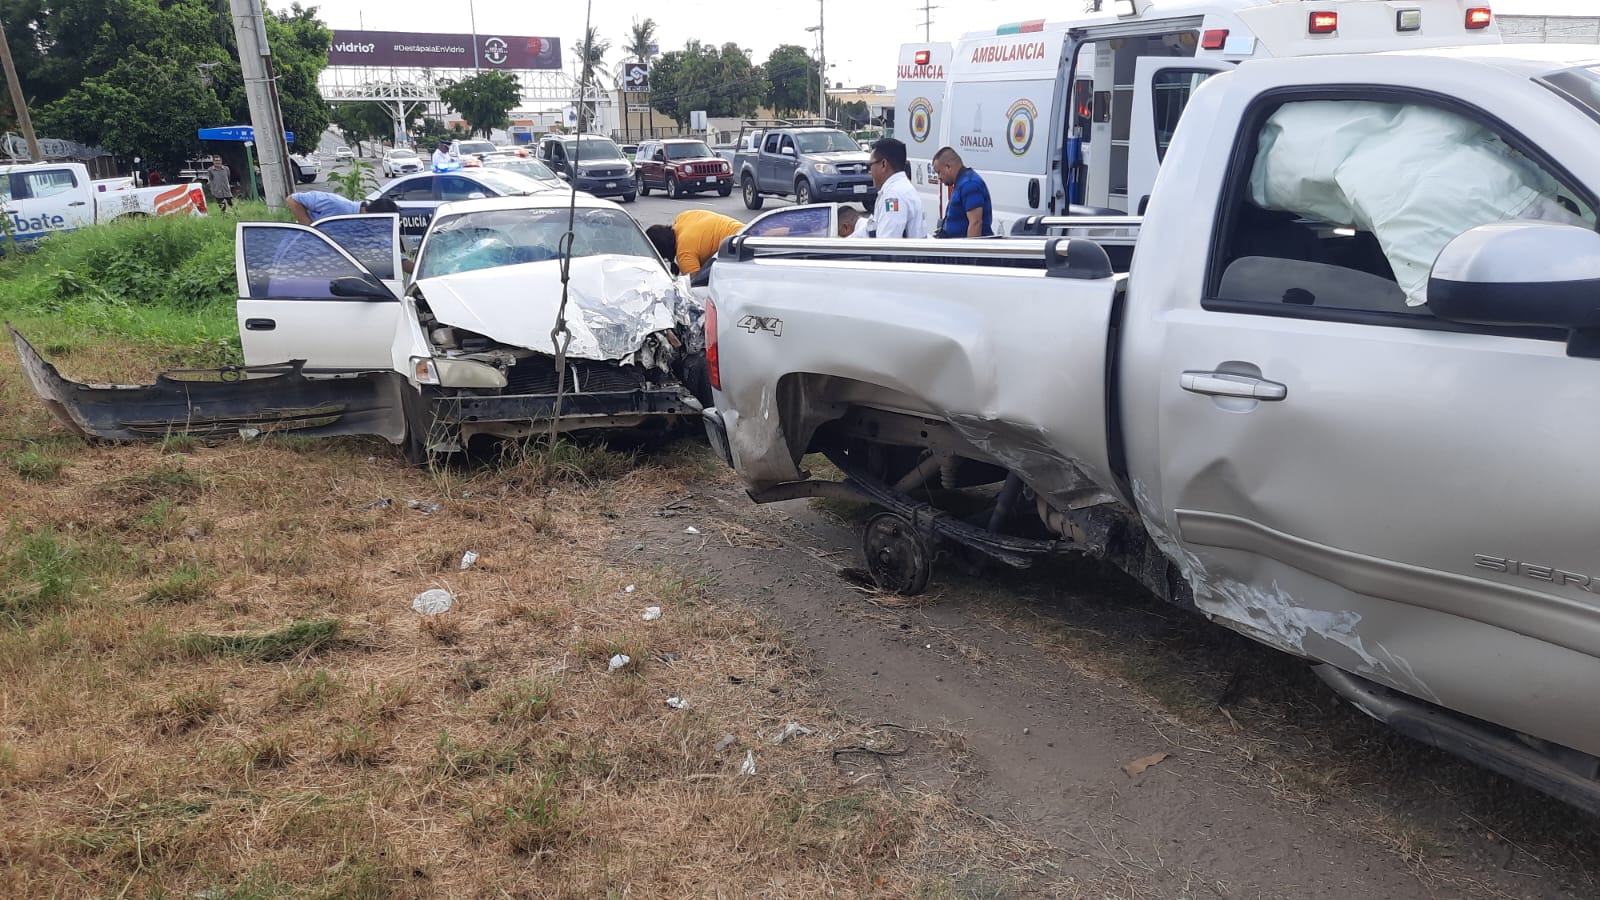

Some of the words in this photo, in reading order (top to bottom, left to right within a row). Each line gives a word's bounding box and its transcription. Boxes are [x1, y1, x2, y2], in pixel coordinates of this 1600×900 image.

[336, 42, 375, 53] vidrio?
[971, 43, 1045, 63] AMBULANCIA
[960, 136, 993, 148] SINALOA
[1473, 553, 1600, 594] SIER
